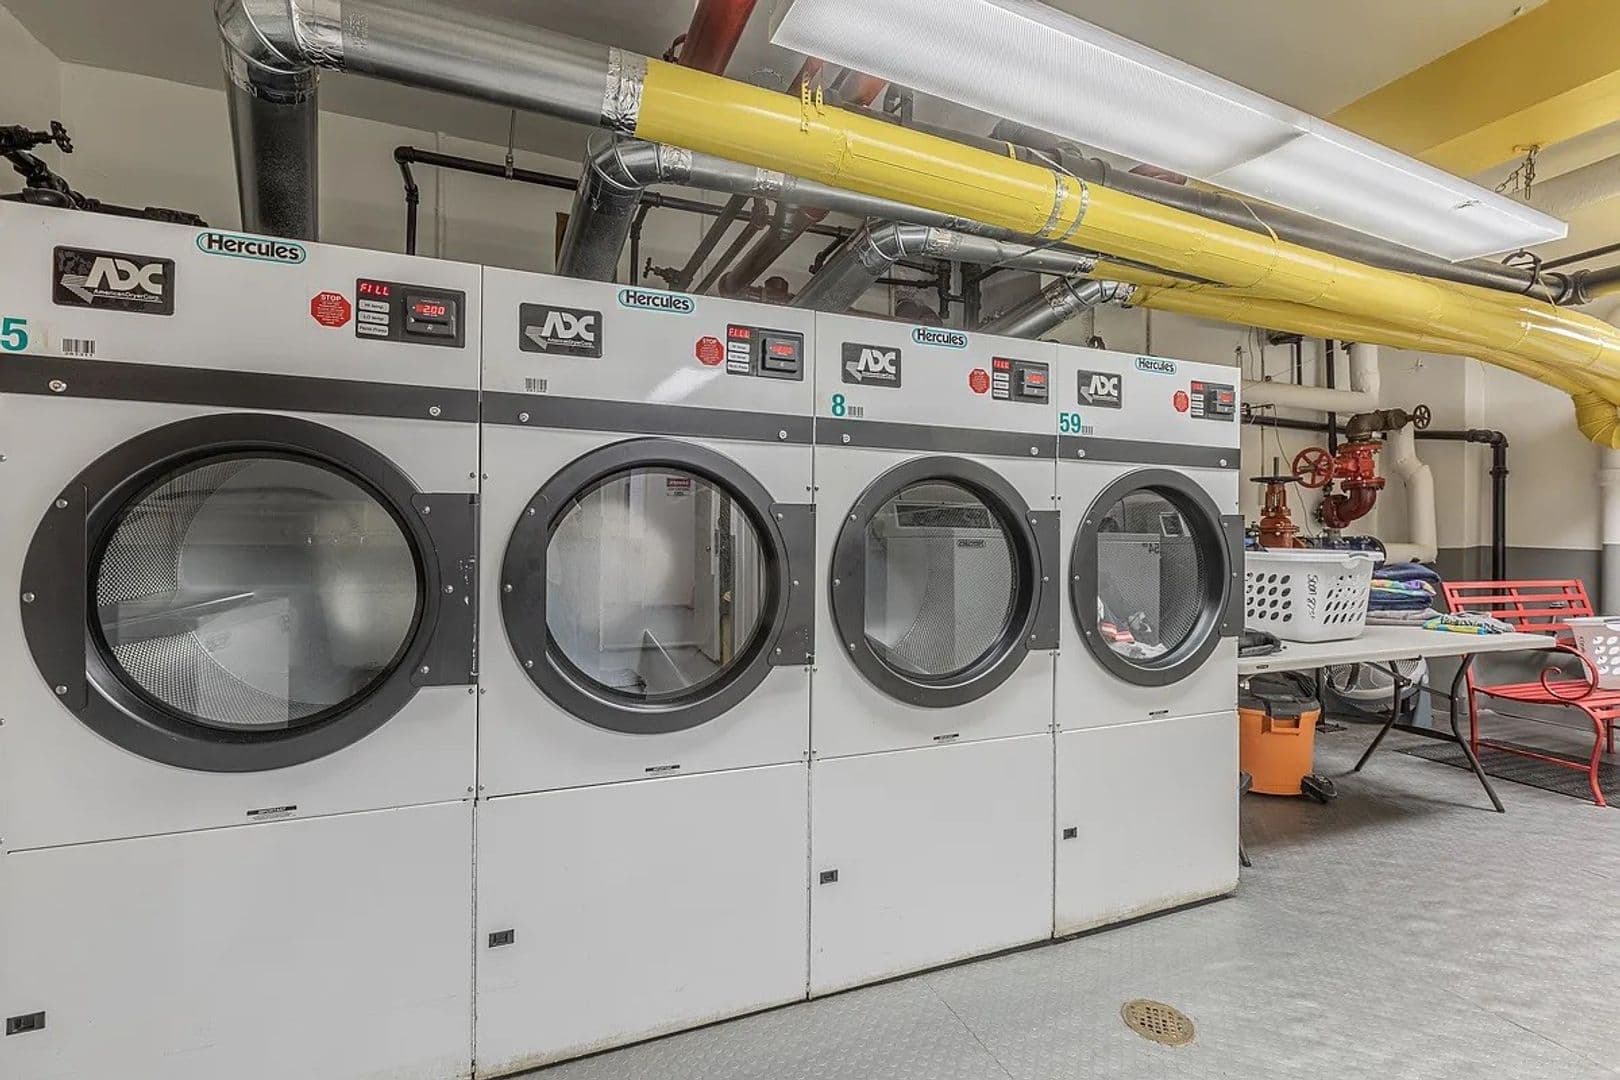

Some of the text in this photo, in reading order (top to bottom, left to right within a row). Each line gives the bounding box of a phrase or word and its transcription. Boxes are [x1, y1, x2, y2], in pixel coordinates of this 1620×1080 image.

[207, 233, 299, 260] Hercules
[84, 256, 163, 295] ADC
[320, 293, 342, 301] STOP
[360, 283, 390, 296] FILL
[626, 290, 689, 311] Hercules
[1, 317, 28, 352] 5
[541, 311, 594, 342] ADC
[917, 328, 964, 346] Hercules
[856, 348, 896, 374] ADC
[1138, 357, 1174, 373] Hercules
[1088, 375, 1118, 396] ADC
[831, 393, 846, 417] 8
[1059, 412, 1081, 433] 59
